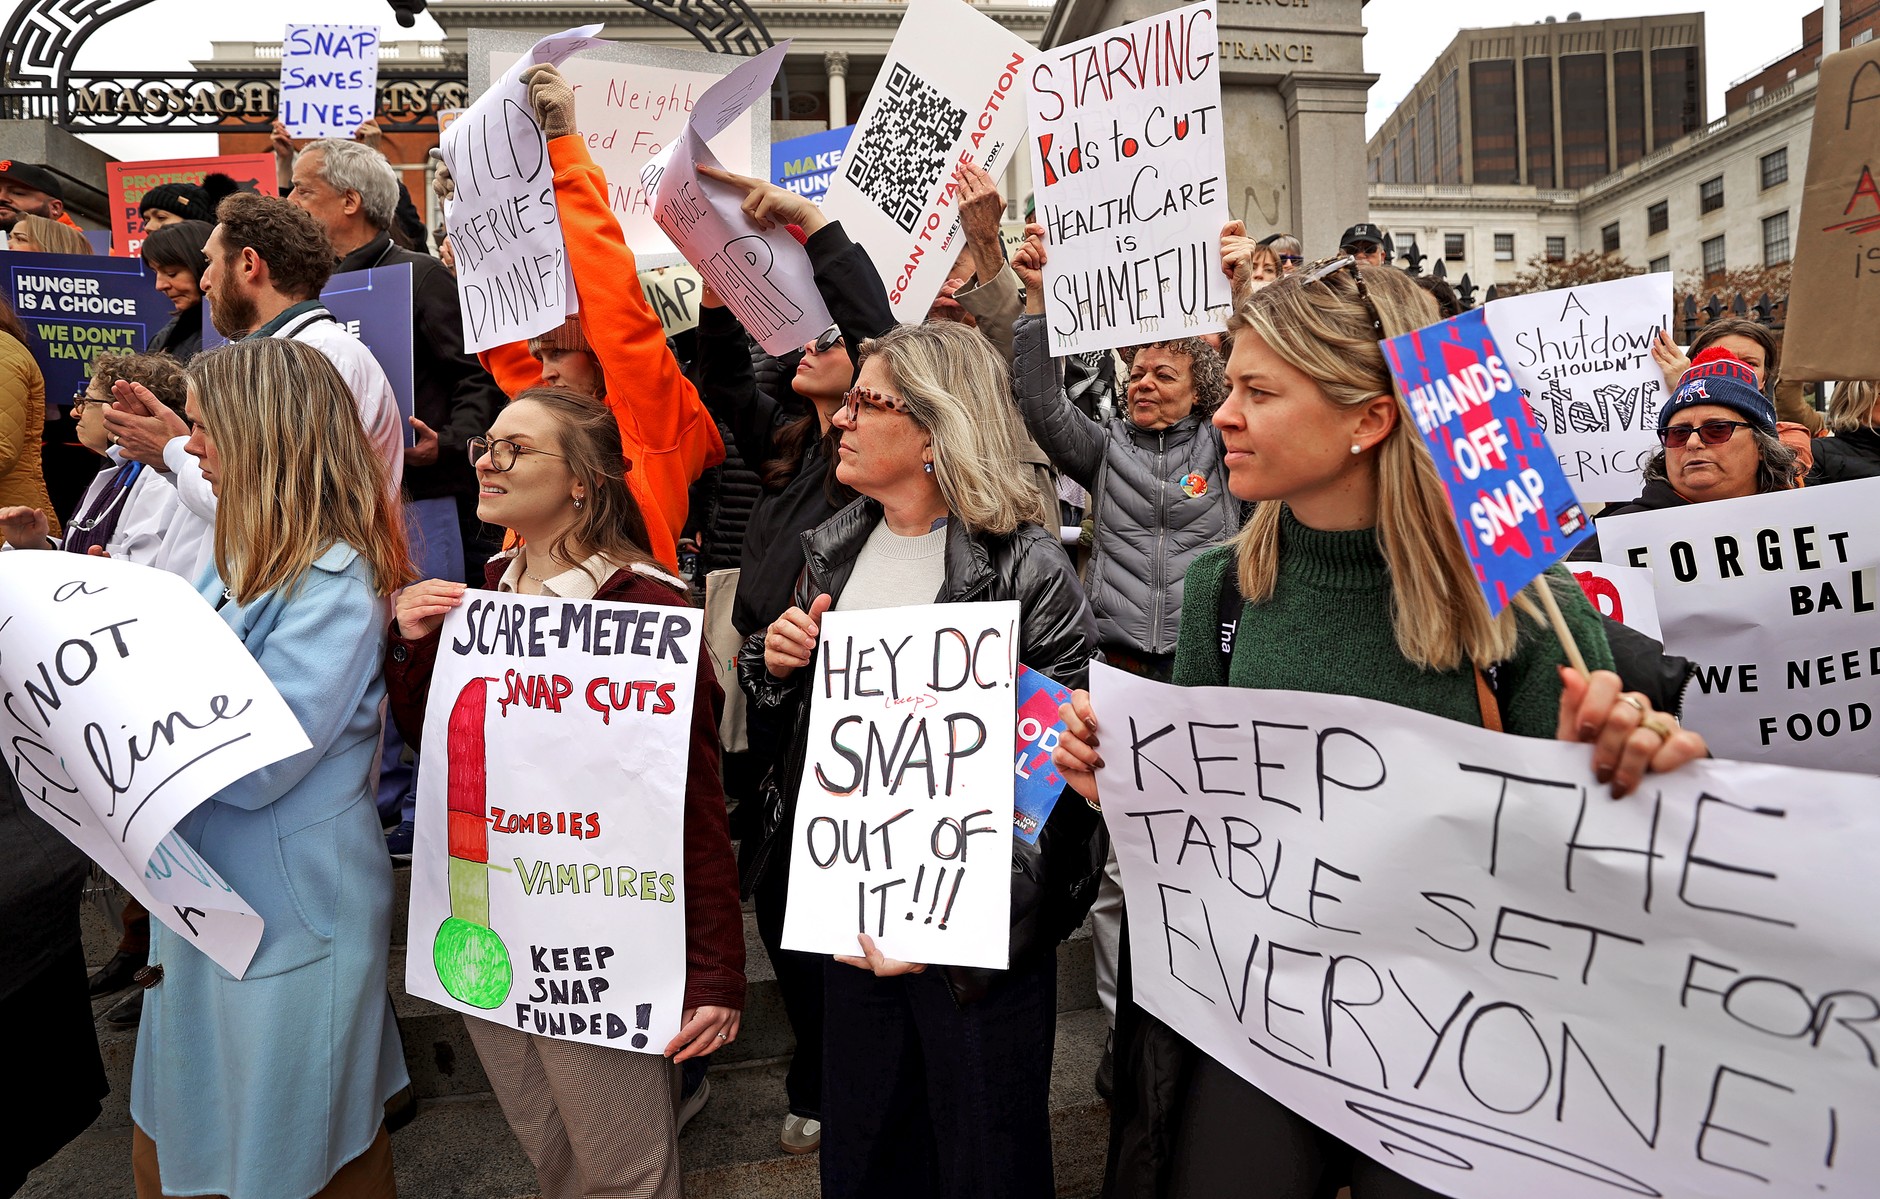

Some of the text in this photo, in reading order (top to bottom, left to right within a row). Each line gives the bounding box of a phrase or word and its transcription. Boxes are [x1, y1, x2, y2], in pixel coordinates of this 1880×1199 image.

[290, 28, 376, 60] SNAP
[1032, 9, 1214, 122] STARVING
[1218, 41, 1315, 63] TRANCE
[284, 67, 363, 90] SAVES
[606, 78, 694, 121] Neighb
[285, 101, 364, 127] LIVES
[784, 150, 842, 177] MAKE
[1038, 122, 1100, 187] Kids
[1108, 118, 1139, 162] to
[889, 244, 925, 306] SCAN
[919, 212, 941, 244] TO
[970, 51, 1026, 150] ACTION
[449, 187, 556, 276] DESERVES
[1116, 235, 1137, 253] is
[17, 274, 99, 296] HUNGER
[18, 293, 137, 316] IS A CHOICE
[464, 247, 566, 343] DINNER
[1053, 240, 1231, 338] SHAMEFUL
[1560, 291, 1590, 322] A
[37, 324, 136, 346] WE DON'T
[1537, 353, 1648, 380] SHOULDN'T
[1410, 354, 1513, 436] #HANDS
[1452, 418, 1509, 481] OFF
[1470, 467, 1545, 547] SNAP
[452, 598, 692, 664] SCARE-METER
[1221, 619, 1237, 654] Tna
[23, 618, 138, 728] NOT
[823, 619, 1015, 701] HEY DC!
[1697, 664, 1759, 694] WE
[497, 668, 676, 722] SNAP CUTS
[1759, 702, 1873, 746] FOOD
[83, 694, 254, 818] line
[814, 711, 987, 800] SNAP
[490, 806, 601, 840] ZOMBIES
[807, 808, 997, 871] OUT OF
[1129, 716, 1798, 930] KEEP THE
[513, 857, 676, 903] VAMPIRES
[530, 945, 615, 973] KEEP
[1124, 809, 1880, 1068] TABLE SET FOR
[529, 976, 610, 1005] SNAP
[515, 1003, 652, 1049] FUNDED!
[1158, 883, 1837, 1191] EVERYONE!
